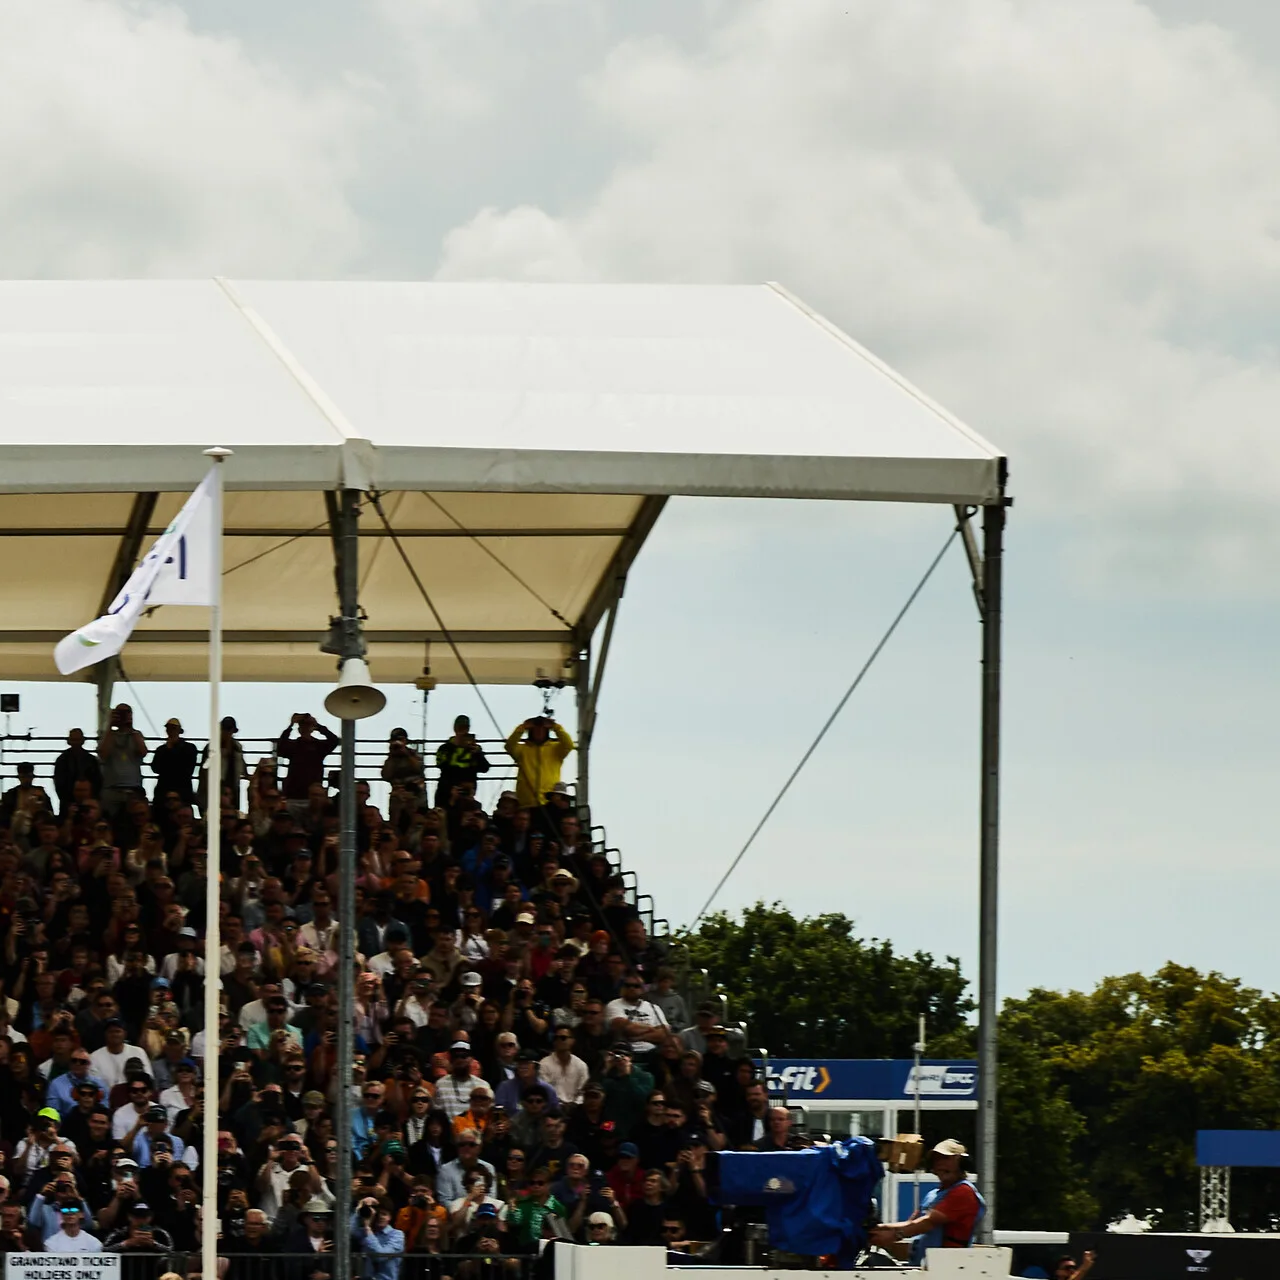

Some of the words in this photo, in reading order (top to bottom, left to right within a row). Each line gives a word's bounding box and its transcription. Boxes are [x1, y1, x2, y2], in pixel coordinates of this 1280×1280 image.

[9, 1256, 80, 1267] GRANDSTAND
[82, 1256, 118, 1267] TICKET
[23, 1270, 72, 1280] HOLDERS
[75, 1270, 102, 1280] ONLY
